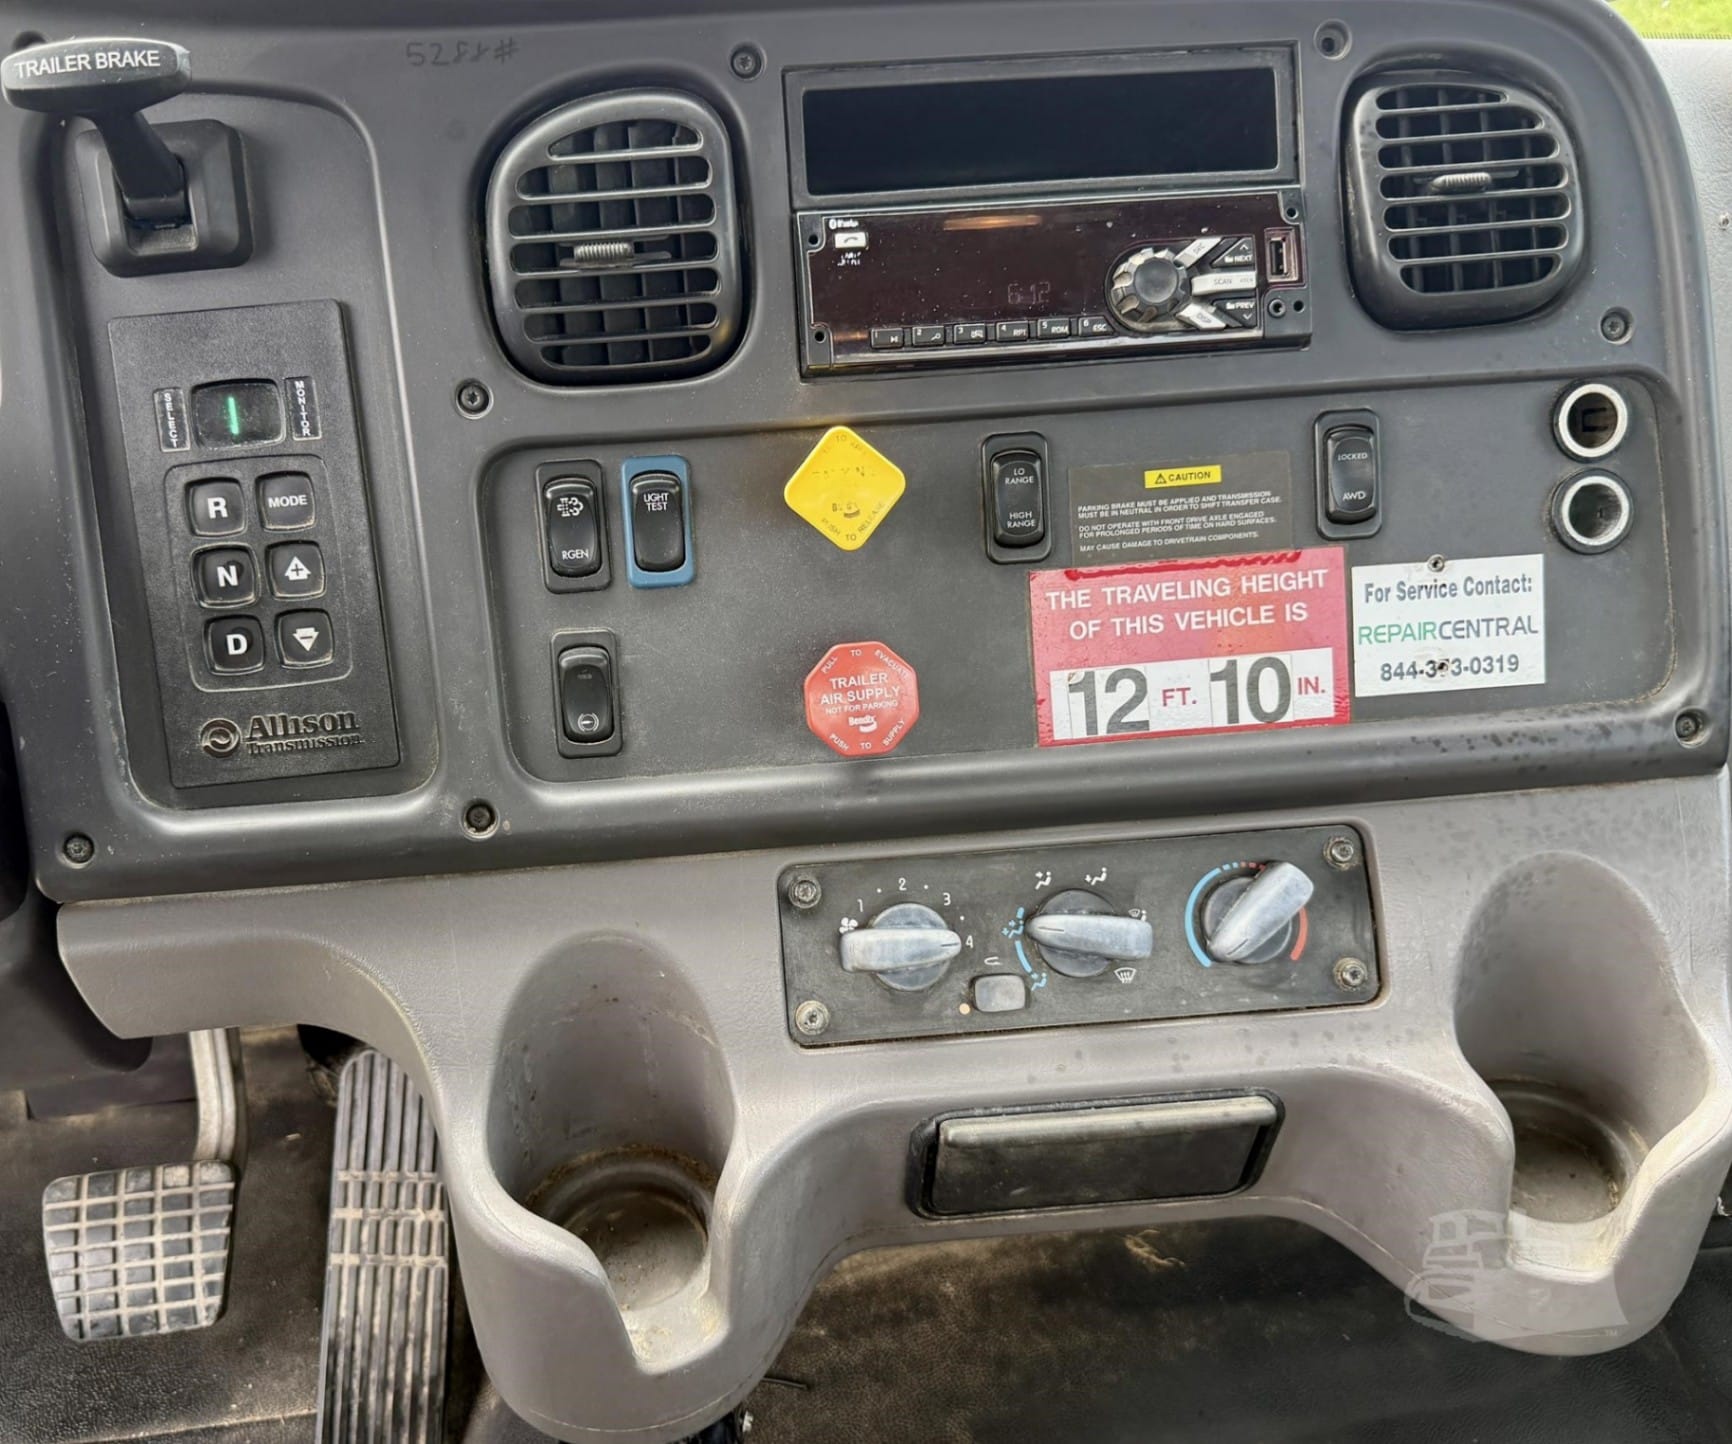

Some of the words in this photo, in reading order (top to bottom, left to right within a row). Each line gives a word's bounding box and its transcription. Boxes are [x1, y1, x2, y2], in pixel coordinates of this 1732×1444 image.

[14, 53, 91, 78] TRAILER
[95, 50, 161, 69] BRAKE
[294, 381, 311, 436] MONITOR
[163, 393, 178, 448] SELECT
[1338, 452, 1368, 461] LOCKED
[1014, 468, 1025, 476] LO
[1168, 471, 1211, 482] CAUTION
[1005, 476, 1034, 485] RANGE
[268, 494, 308, 508] MODE
[644, 492, 670, 503] LIGHT
[1078, 504, 1109, 512] PARKING
[1111, 501, 1136, 510] BRAKE
[1136, 499, 1157, 507] MUST
[1170, 496, 1200, 505] APPLIED
[1218, 491, 1271, 500] TRANSMISSION
[1342, 491, 1366, 501] AWD
[207, 497, 228, 519] R
[646, 502, 668, 512] TEST
[1078, 511, 1098, 519] MUST
[1120, 507, 1152, 516] NEUTRAL
[1163, 504, 1188, 512] ORDER
[1201, 501, 1220, 509] SHIFT
[1222, 498, 1259, 507] TRANSFER
[1007, 519, 1036, 528] RANGE
[1009, 511, 1032, 520] HIGH
[1107, 521, 1140, 530] OPERATE
[1142, 519, 1159, 527] WITH
[1160, 517, 1184, 525] FRONT
[1186, 515, 1208, 524] DRIVE
[1229, 511, 1264, 520] ENGAGED
[1095, 528, 1140, 537] PROLONGED
[1142, 525, 1172, 534] PERIODS
[1096, 542, 1120, 551] CAUSE
[1122, 540, 1152, 549] DAMAGE
[1164, 536, 1206, 545] DRIVETRAIN
[562, 549, 589, 560] RGEN
[216, 565, 239, 587] N
[1046, 588, 1092, 611] THE
[1102, 577, 1231, 606] TRAVELING
[1241, 569, 1328, 595] HEIGHT
[1364, 583, 1390, 604] For
[1396, 579, 1458, 602] Service
[1463, 573, 1532, 596] Contact:
[1069, 620, 1101, 641] OF
[1111, 614, 1164, 637] THIS
[1174, 606, 1275, 631] VEHICLE
[1285, 602, 1308, 622] IS
[1358, 615, 1539, 645] REPAIRCENTRAL
[226, 633, 248, 655] D
[850, 649, 862, 657] TO
[829, 672, 888, 689] TRAILER
[821, 693, 843, 705] AIR
[847, 686, 900, 702] SUPPLY
[1068, 667, 1150, 736] 12
[1161, 687, 1197, 707] FT.
[1209, 656, 1292, 724] 10
[1297, 677, 1326, 696] IN.
[825, 706, 842, 715] NOT
[862, 700, 898, 711] PARKING
[247, 711, 360, 740] Allison
[829, 733, 849, 751] PUSH
[860, 742, 872, 750] TO
[882, 720, 905, 746] SUPPLY
[246, 733, 362, 755] Transmission
[898, 878, 907, 891] 2
[857, 900, 864, 912] 1
[943, 893, 951, 906] 3
[965, 935, 974, 949] 4
